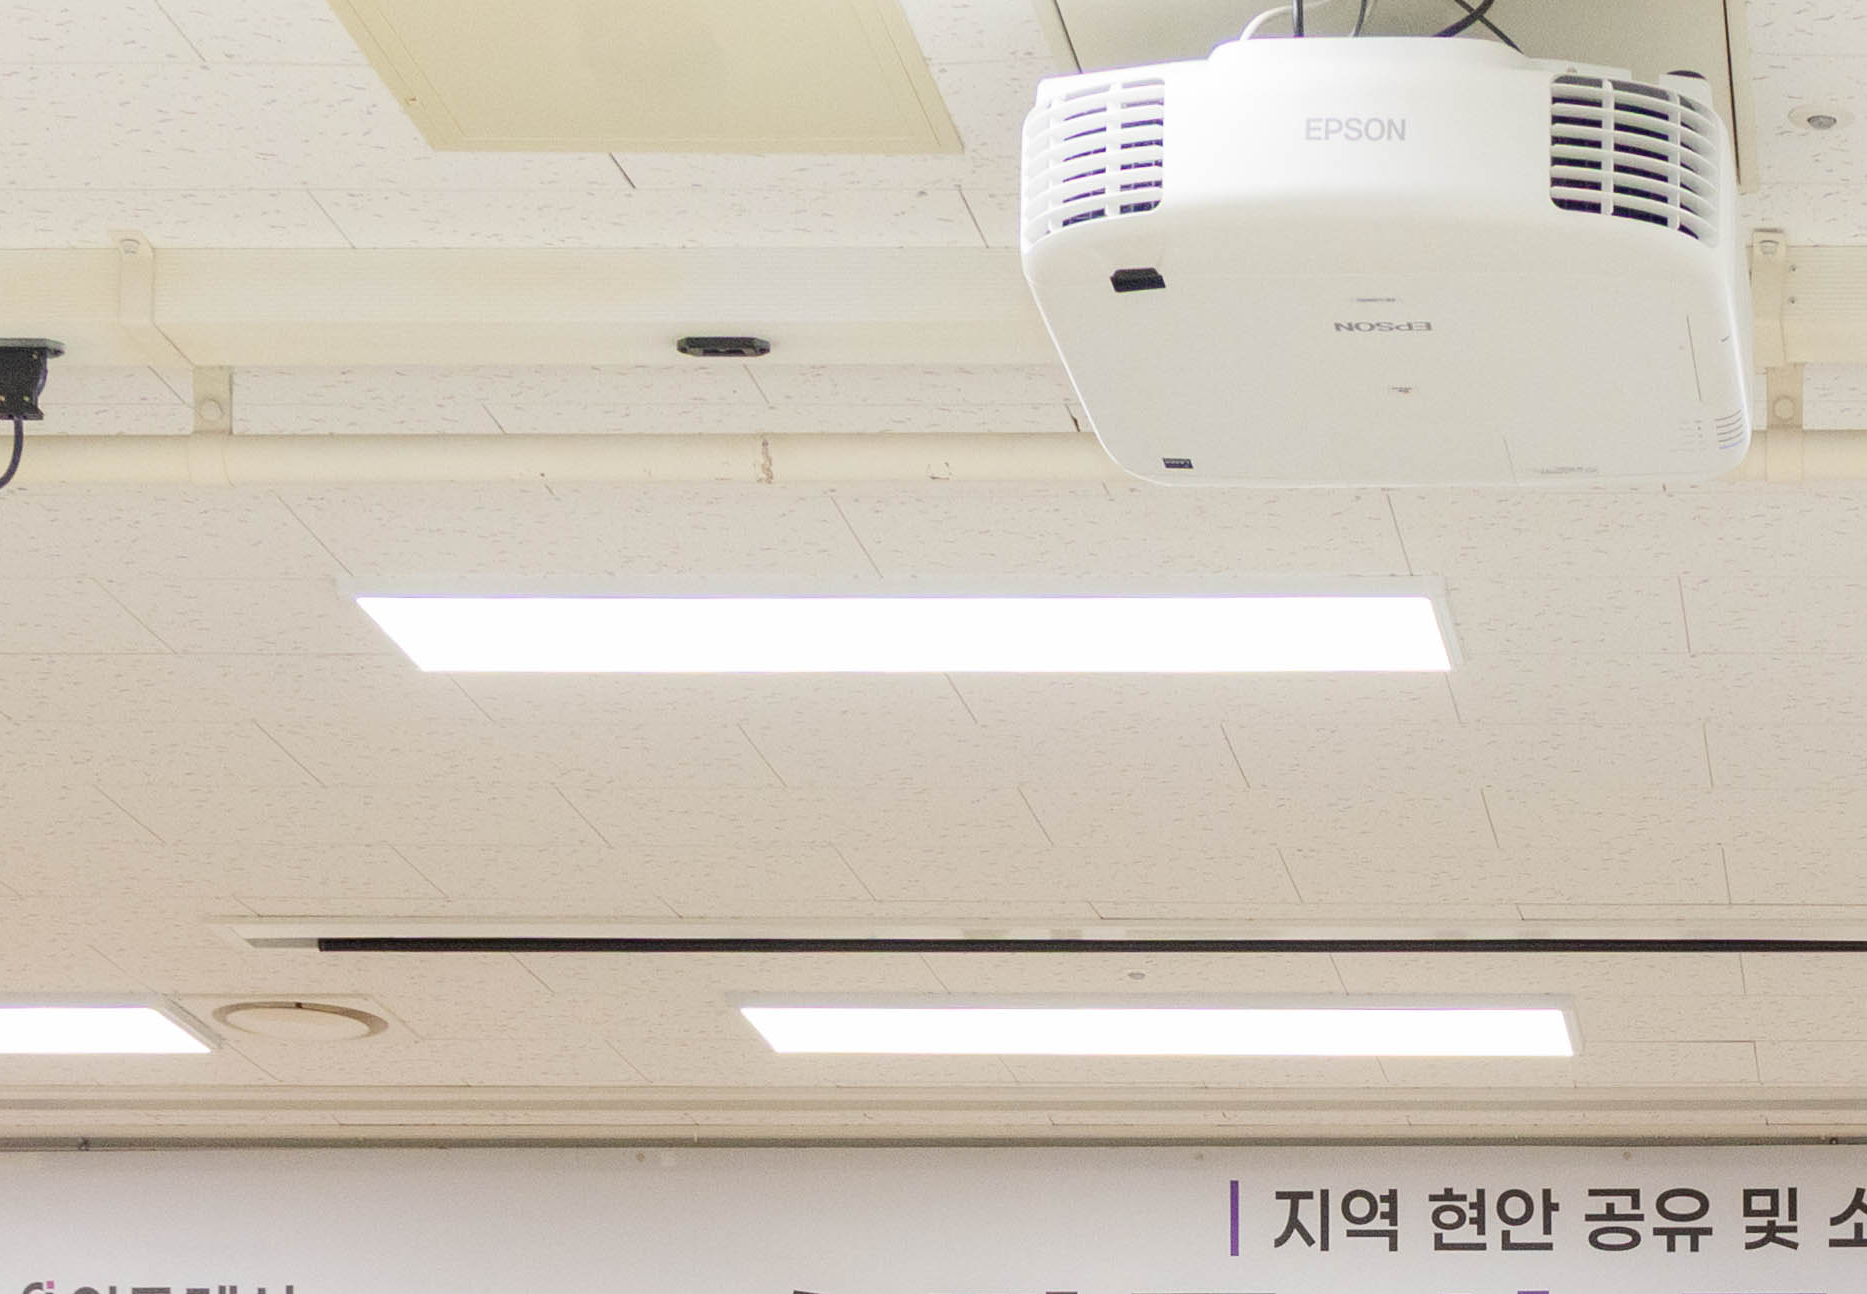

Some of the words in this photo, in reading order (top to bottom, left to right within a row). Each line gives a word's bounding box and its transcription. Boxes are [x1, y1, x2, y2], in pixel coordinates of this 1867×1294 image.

[1304, 118, 1406, 142] EPSON
[1333, 321, 1433, 333] EPSON
[1275, 1188, 1399, 1253] 지역
[1429, 1188, 1561, 1252] 현안
[1585, 1188, 1714, 1254] 공유
[1743, 1188, 1800, 1252] 및
